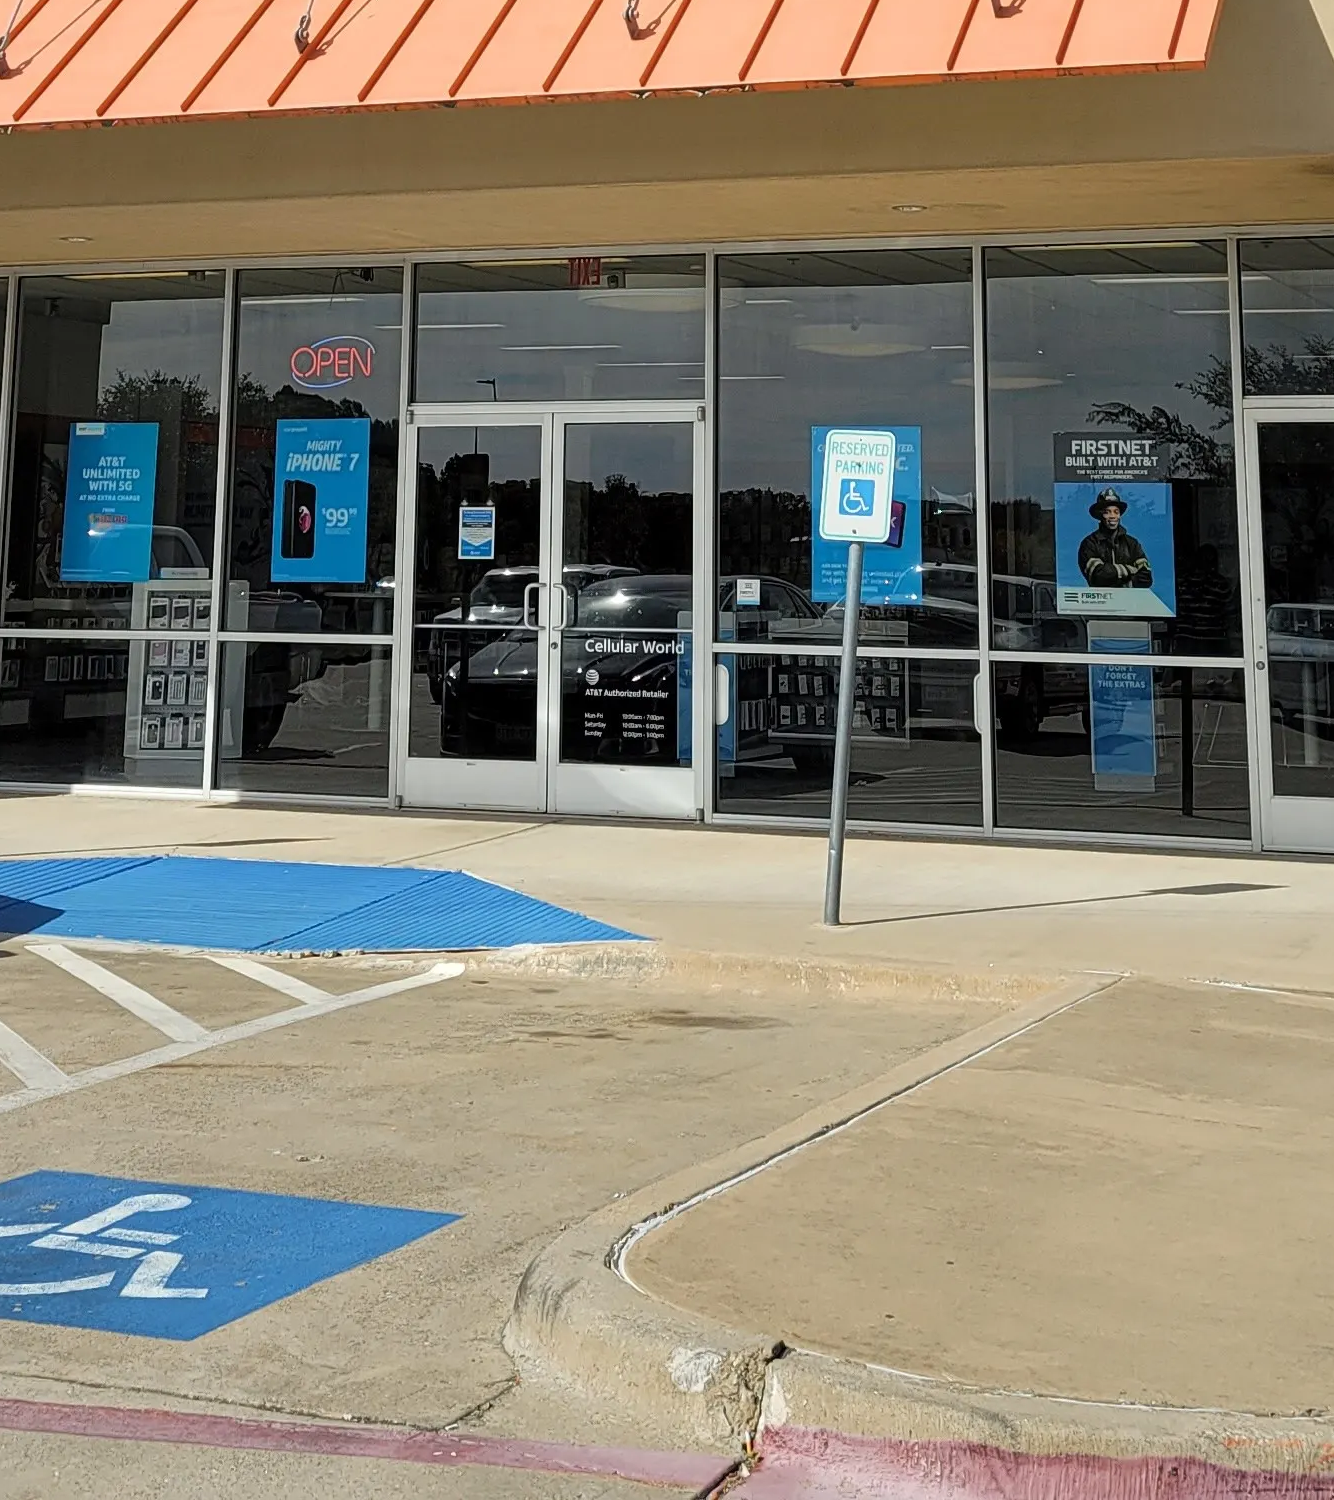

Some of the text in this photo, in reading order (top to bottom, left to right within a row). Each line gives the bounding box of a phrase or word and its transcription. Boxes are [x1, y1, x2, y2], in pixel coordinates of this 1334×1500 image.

[291, 347, 372, 378] OPEN
[306, 440, 342, 451] MIGHTY
[831, 441, 889, 457] RESERVED
[1071, 440, 1153, 455] FIRSTNET
[98, 456, 126, 467] AT&T
[286, 452, 359, 472] iPHONE 7
[1065, 456, 1159, 467] BUILT WITH AT&T
[835, 460, 884, 475] PARKING
[82, 468, 140, 479] UNLIMITED
[89, 480, 133, 491] WITH 5G
[585, 638, 685, 655] Cellular World
[1105, 672, 1137, 680] FORGET
[1098, 680, 1146, 688] THE EXTRAS
[585, 688, 668, 699] AT&T Authorized Retailer
